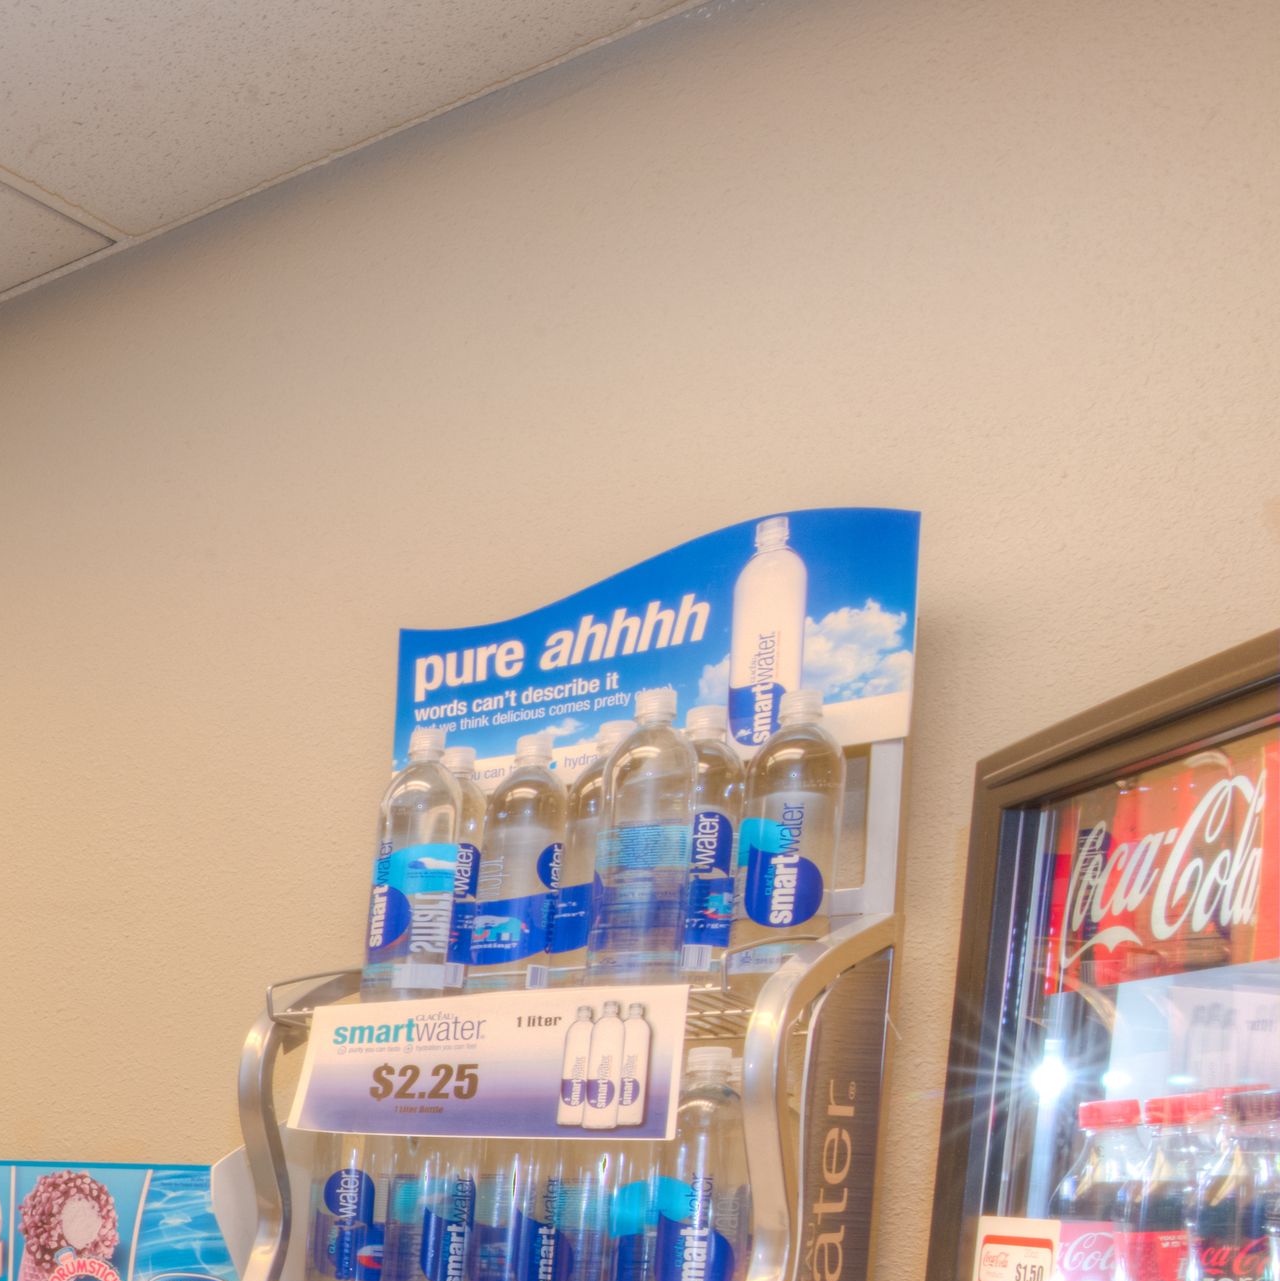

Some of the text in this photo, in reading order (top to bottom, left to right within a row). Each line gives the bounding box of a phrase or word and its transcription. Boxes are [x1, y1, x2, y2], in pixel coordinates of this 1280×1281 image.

[414, 593, 711, 703] pure ahhhh
[414, 672, 619, 723] words can't describe it
[440, 720, 458, 734] we
[459, 713, 489, 731] think
[492, 706, 546, 728] delicious
[548, 699, 591, 718] comes
[593, 692, 632, 712] pretty
[483, 766, 506, 781] can
[769, 801, 805, 925] smartwater
[1060, 768, 1267, 970] Coca-Cola
[332, 1016, 487, 1046] smartwater
[516, 1015, 562, 1028] 1 liter
[369, 1062, 479, 1102] $2.25
